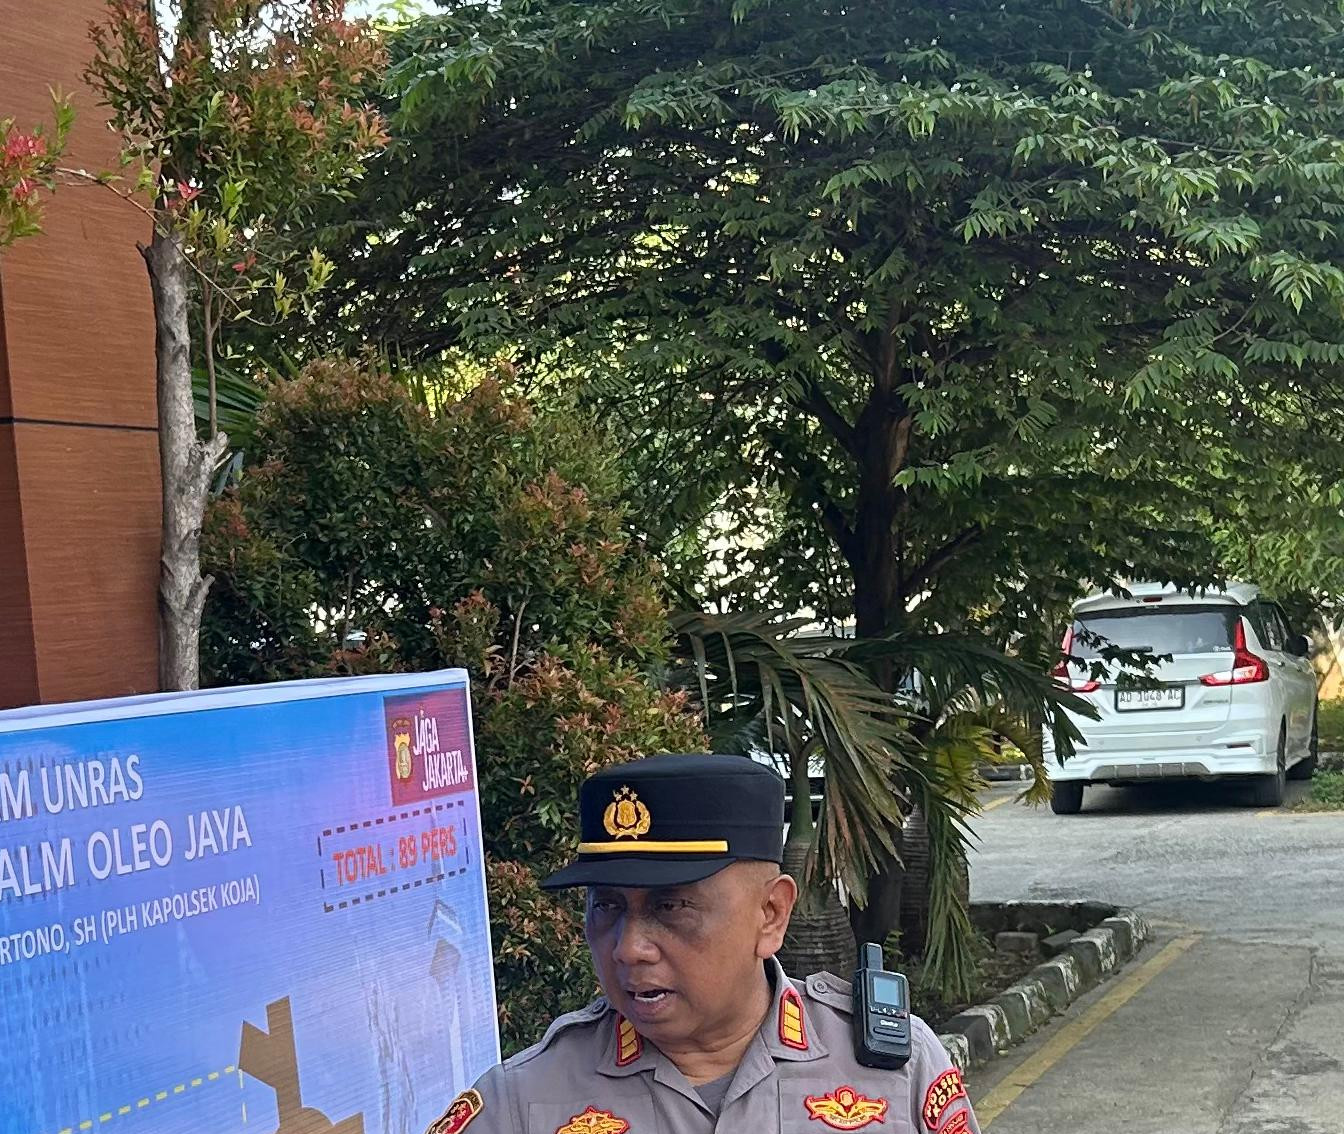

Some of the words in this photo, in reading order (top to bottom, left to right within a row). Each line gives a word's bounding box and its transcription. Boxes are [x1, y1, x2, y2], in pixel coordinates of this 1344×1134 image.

[413, 716, 439, 755] JAGA
[43, 755, 143, 813] UNRAS
[422, 750, 466, 791] JAKARTA
[87, 820, 174, 881] OLEO
[183, 805, 253, 861] JAYA
[332, 843, 388, 886] TOTAL
[398, 835, 417, 869] 89
[421, 825, 457, 862] PERS
[74, 918, 97, 946] SH
[102, 907, 139, 947] (PLH
[143, 891, 218, 935] KAPOLSEK
[221, 880, 262, 920] KOJA)
